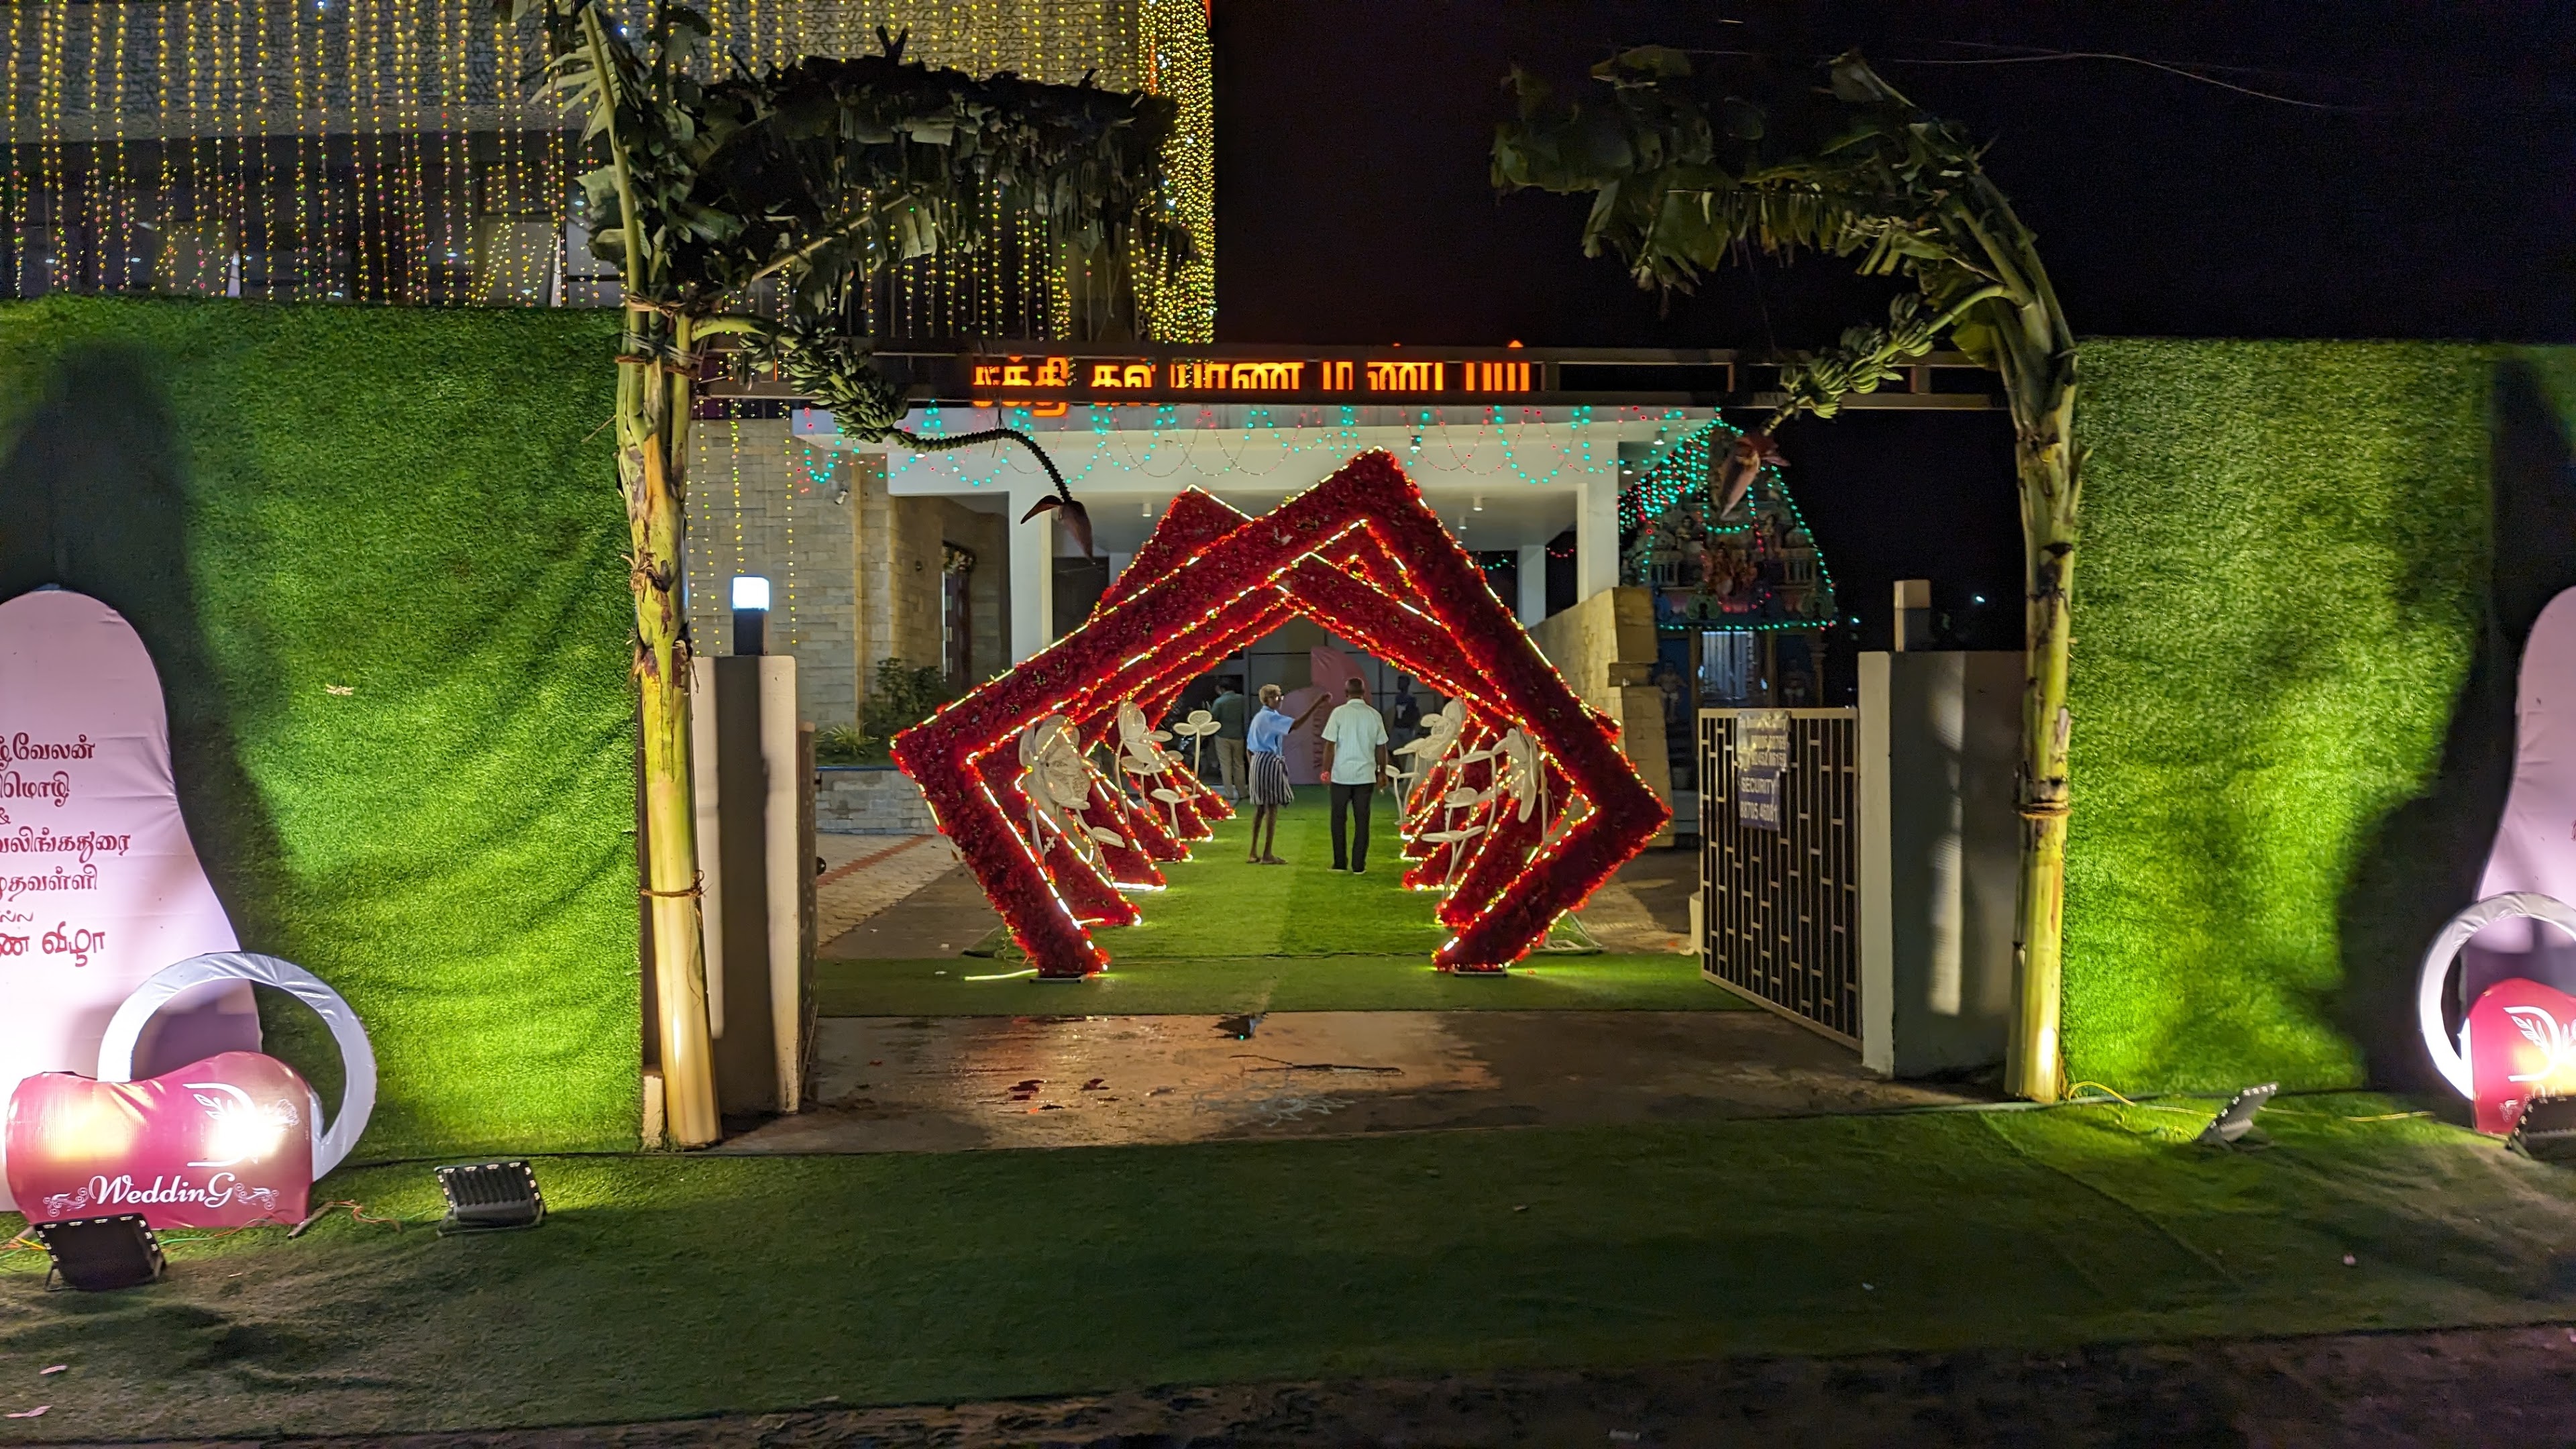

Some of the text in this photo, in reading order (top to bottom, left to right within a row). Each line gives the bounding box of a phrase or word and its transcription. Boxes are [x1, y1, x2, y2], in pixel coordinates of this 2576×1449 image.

[0, 771, 70, 807] மொழி
[1741, 777, 1774, 794] SECURITY
[42, 921, 105, 967] விழா
